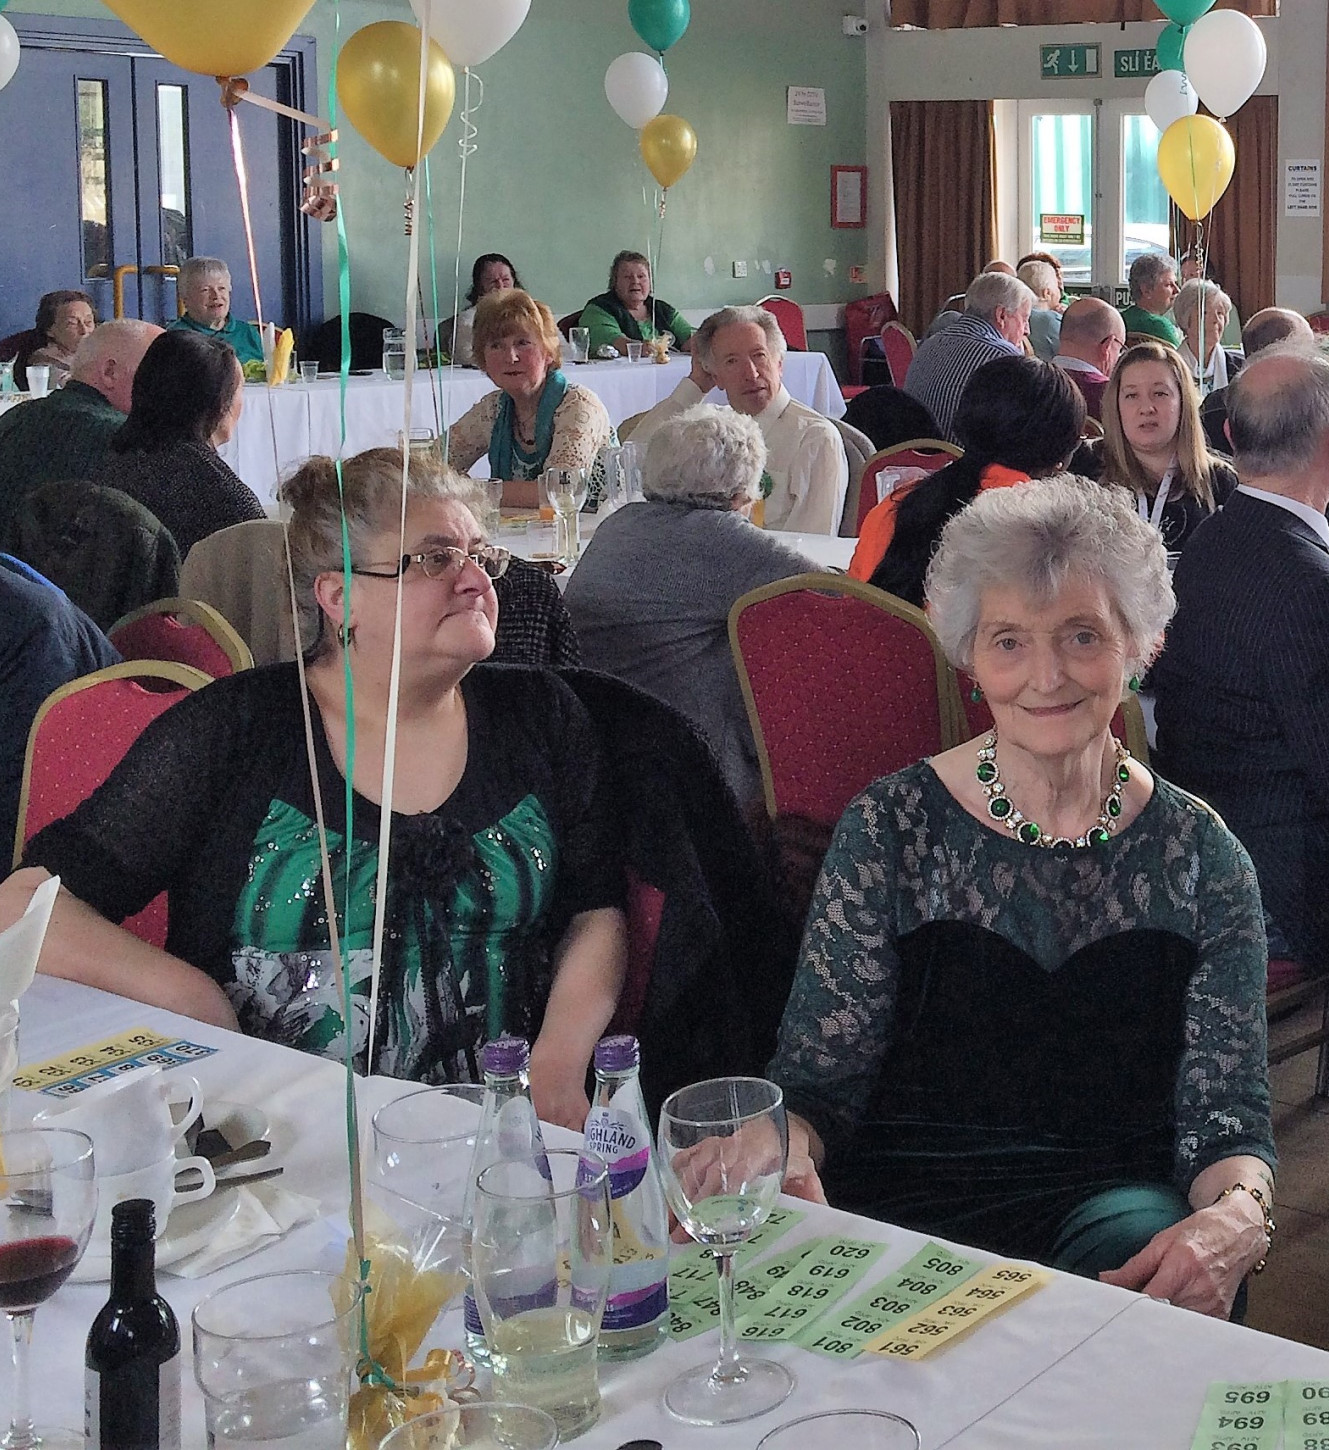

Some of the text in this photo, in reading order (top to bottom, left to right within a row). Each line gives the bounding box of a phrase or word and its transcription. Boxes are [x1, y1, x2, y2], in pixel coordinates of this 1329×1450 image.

[1144, 50, 1160, 71] ÉA
[1043, 216, 1081, 224] EMERGENCY
[590, 1127, 636, 1149] GHLAND
[589, 1141, 618, 1154] SPRING
[829, 1245, 870, 1260] 620
[808, 1265, 850, 1279] 619
[922, 1257, 964, 1276] 805
[672, 1268, 713, 1281] 717
[991, 1269, 1032, 1283] 565
[787, 1285, 829, 1300] 618
[896, 1277, 938, 1295] 804
[965, 1287, 1006, 1300] 564
[869, 1296, 911, 1314] 803
[937, 1305, 978, 1317] 563
[764, 1306, 808, 1319] 617
[840, 1315, 883, 1334] 802
[907, 1322, 949, 1336] 562
[742, 1326, 785, 1338] 616
[812, 1336, 854, 1354] 801
[878, 1341, 920, 1356] 561
[1224, 1391, 1271, 1404] 695
[1218, 1416, 1265, 1430] 694
